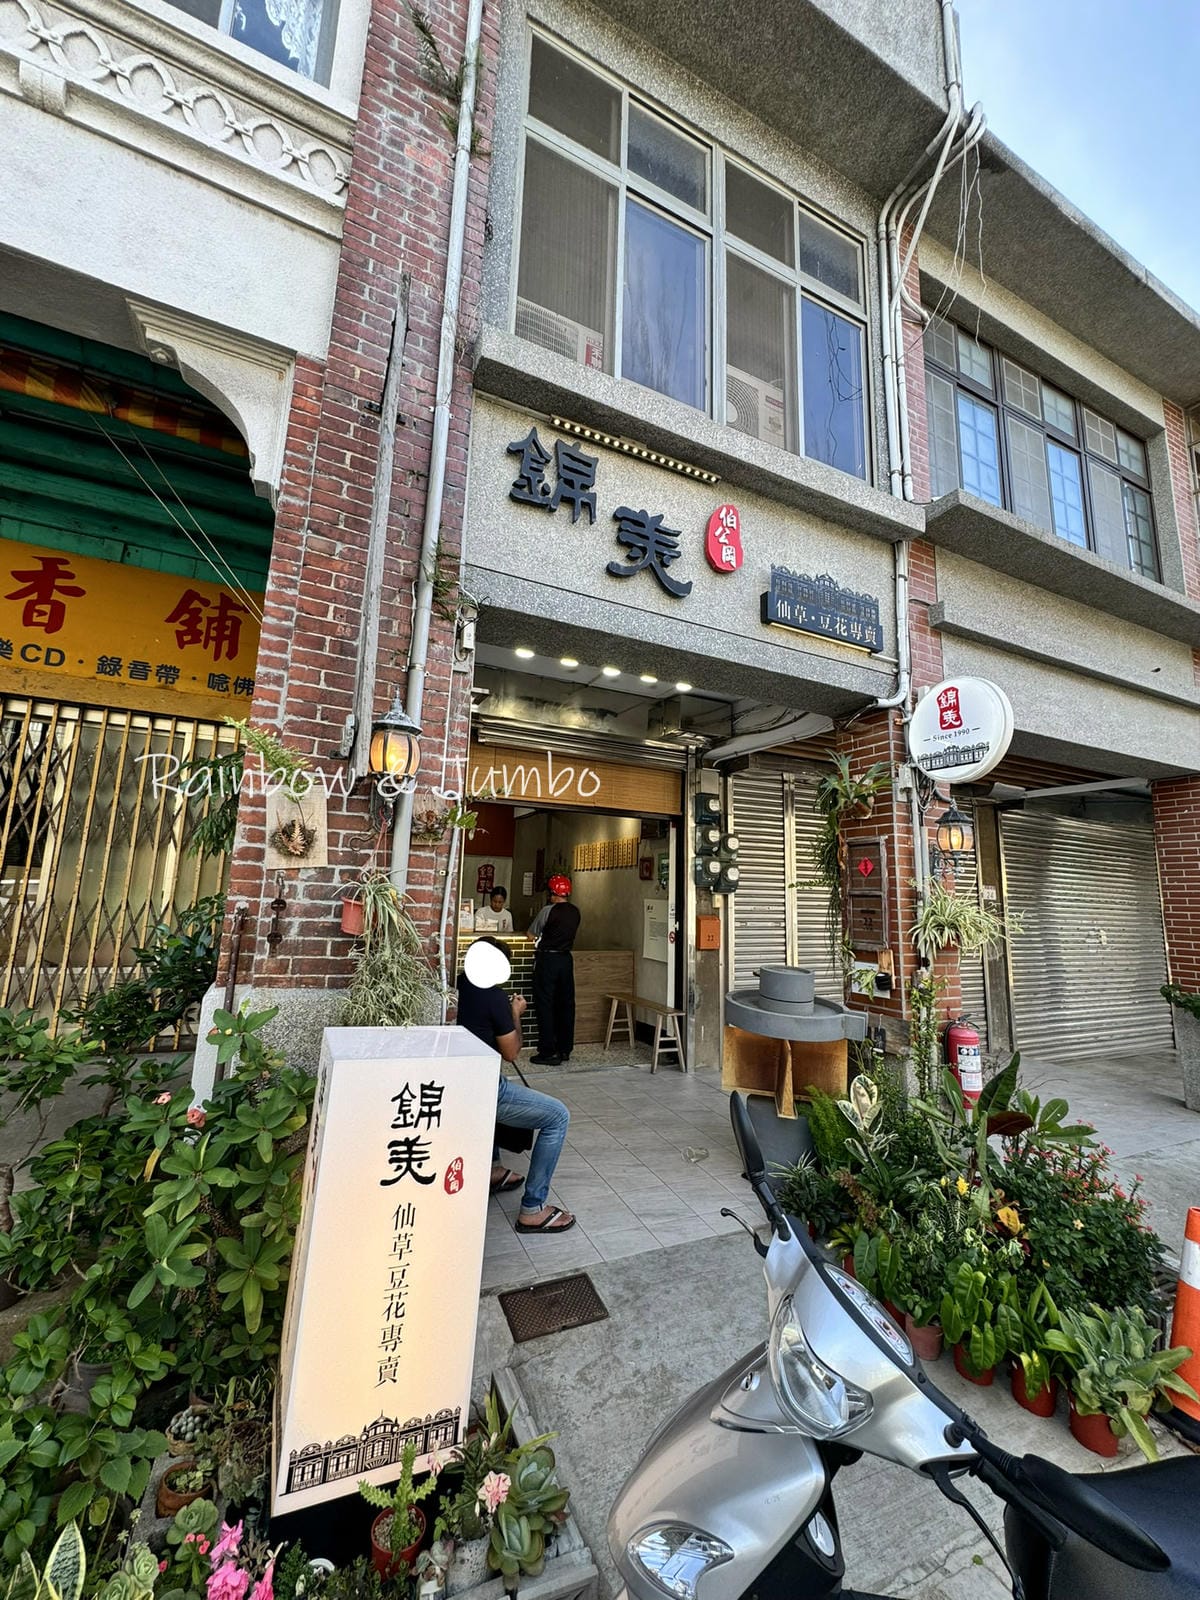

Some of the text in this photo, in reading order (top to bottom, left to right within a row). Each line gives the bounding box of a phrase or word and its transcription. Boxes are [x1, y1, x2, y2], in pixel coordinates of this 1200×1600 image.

[507, 427, 693, 598] 錦美
[932, 728, 970, 742] Since 1990
[938, 690, 961, 727] 錦美
[380, 1080, 445, 1187] 錦美
[374, 1202, 417, 1389] 仙草豆花專賣
